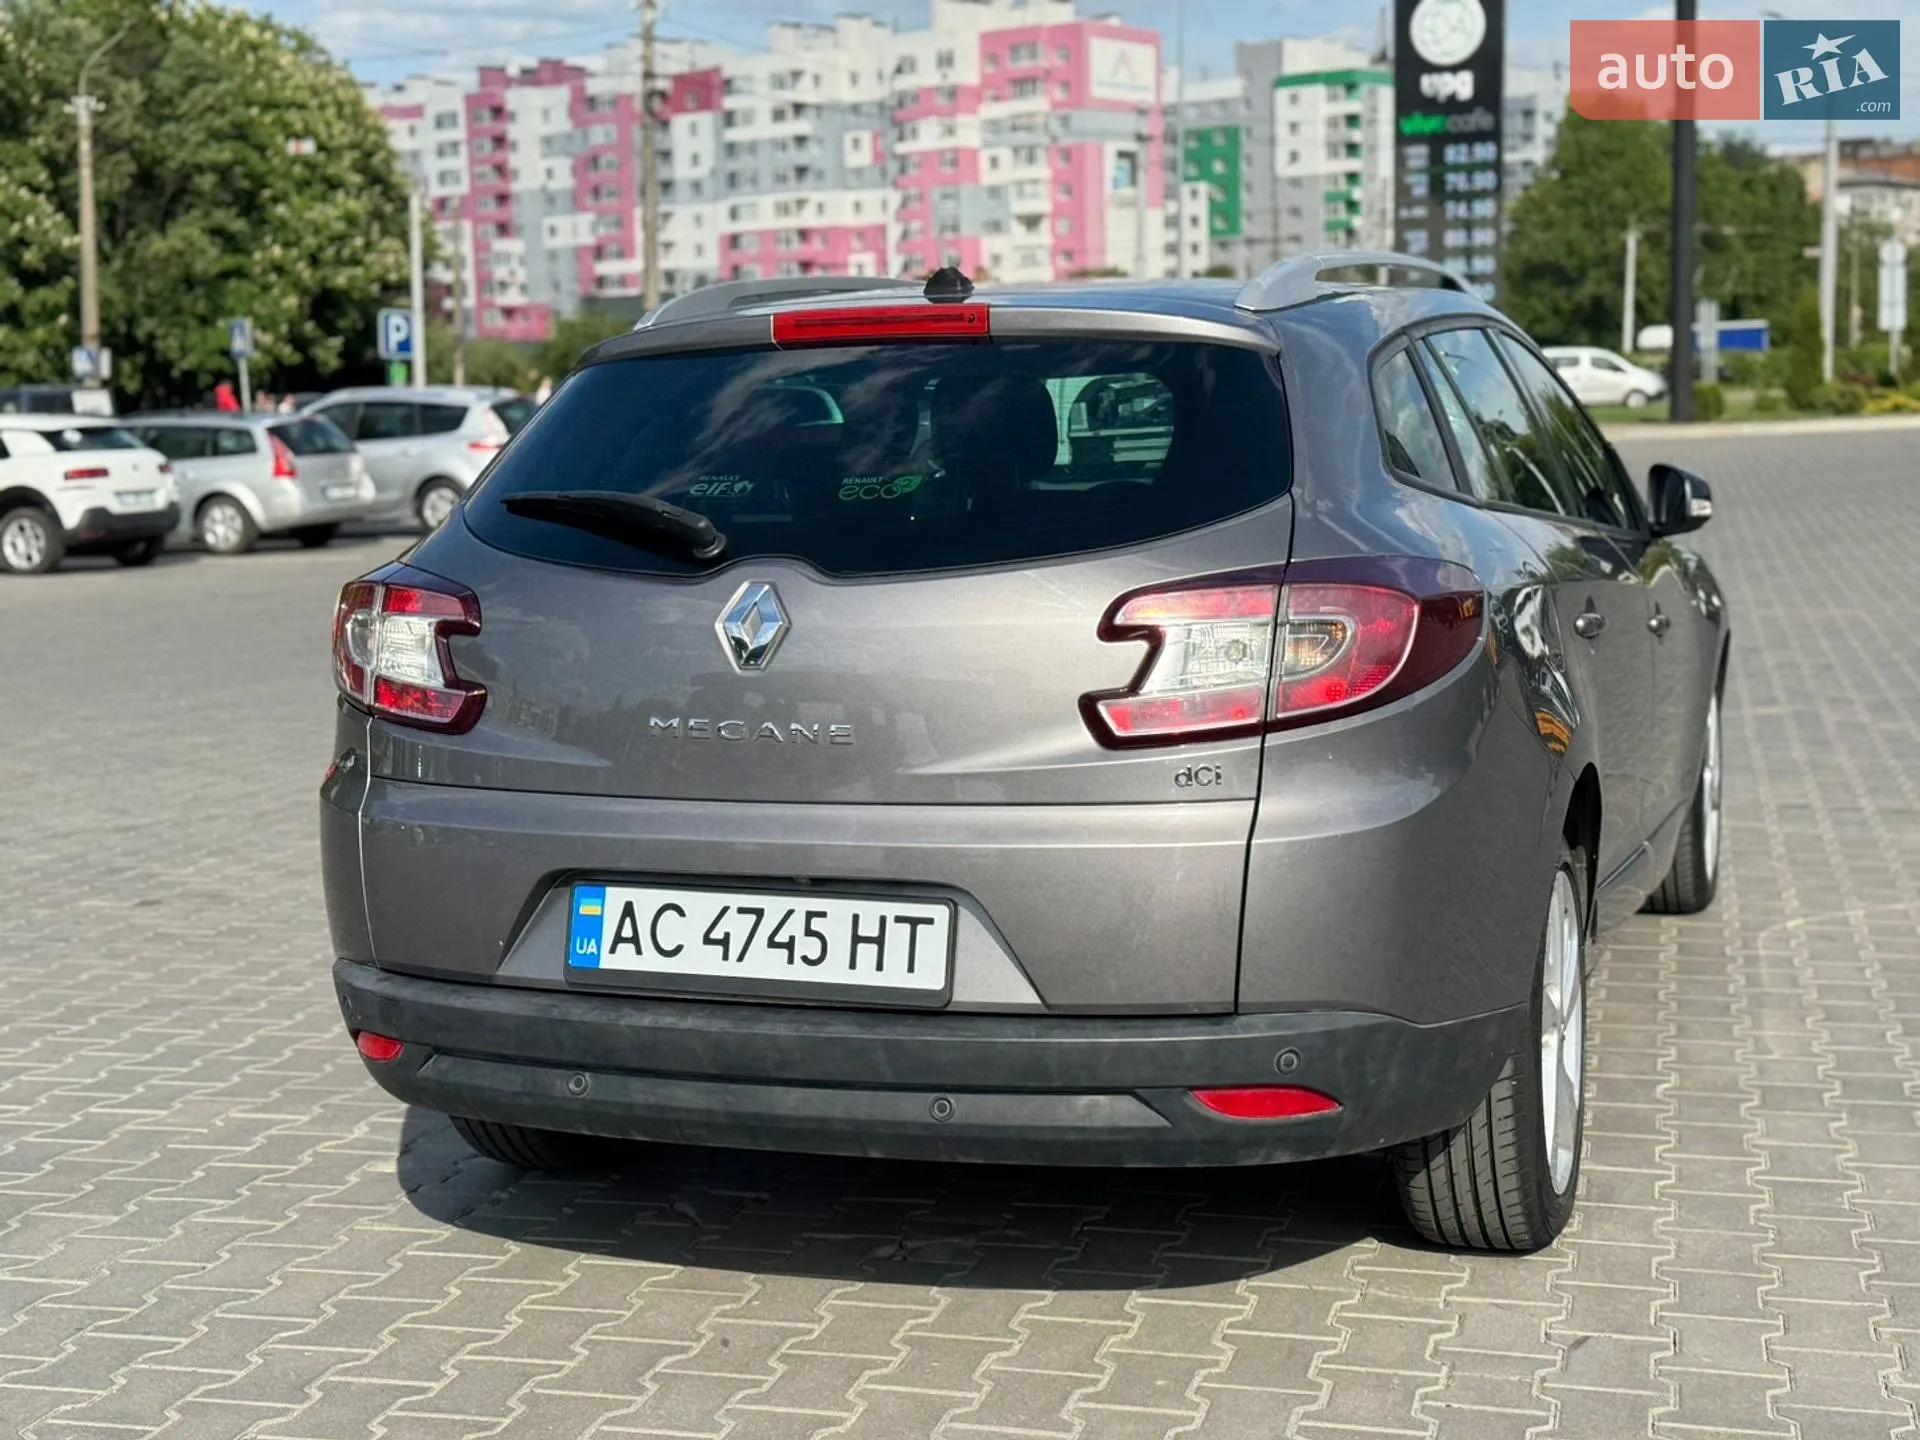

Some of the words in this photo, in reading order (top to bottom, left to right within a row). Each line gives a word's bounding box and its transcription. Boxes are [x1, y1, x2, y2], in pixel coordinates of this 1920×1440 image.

[1420, 70, 1474, 103] upg
[388, 313, 409, 352] P
[841, 476, 885, 485] RENAULT
[648, 716, 857, 746] MEGANE
[1174, 763, 1222, 788] dCi
[575, 936, 598, 956] UA
[608, 900, 687, 958] AC
[702, 904, 828, 967] 4745
[848, 913, 935, 974] HT
